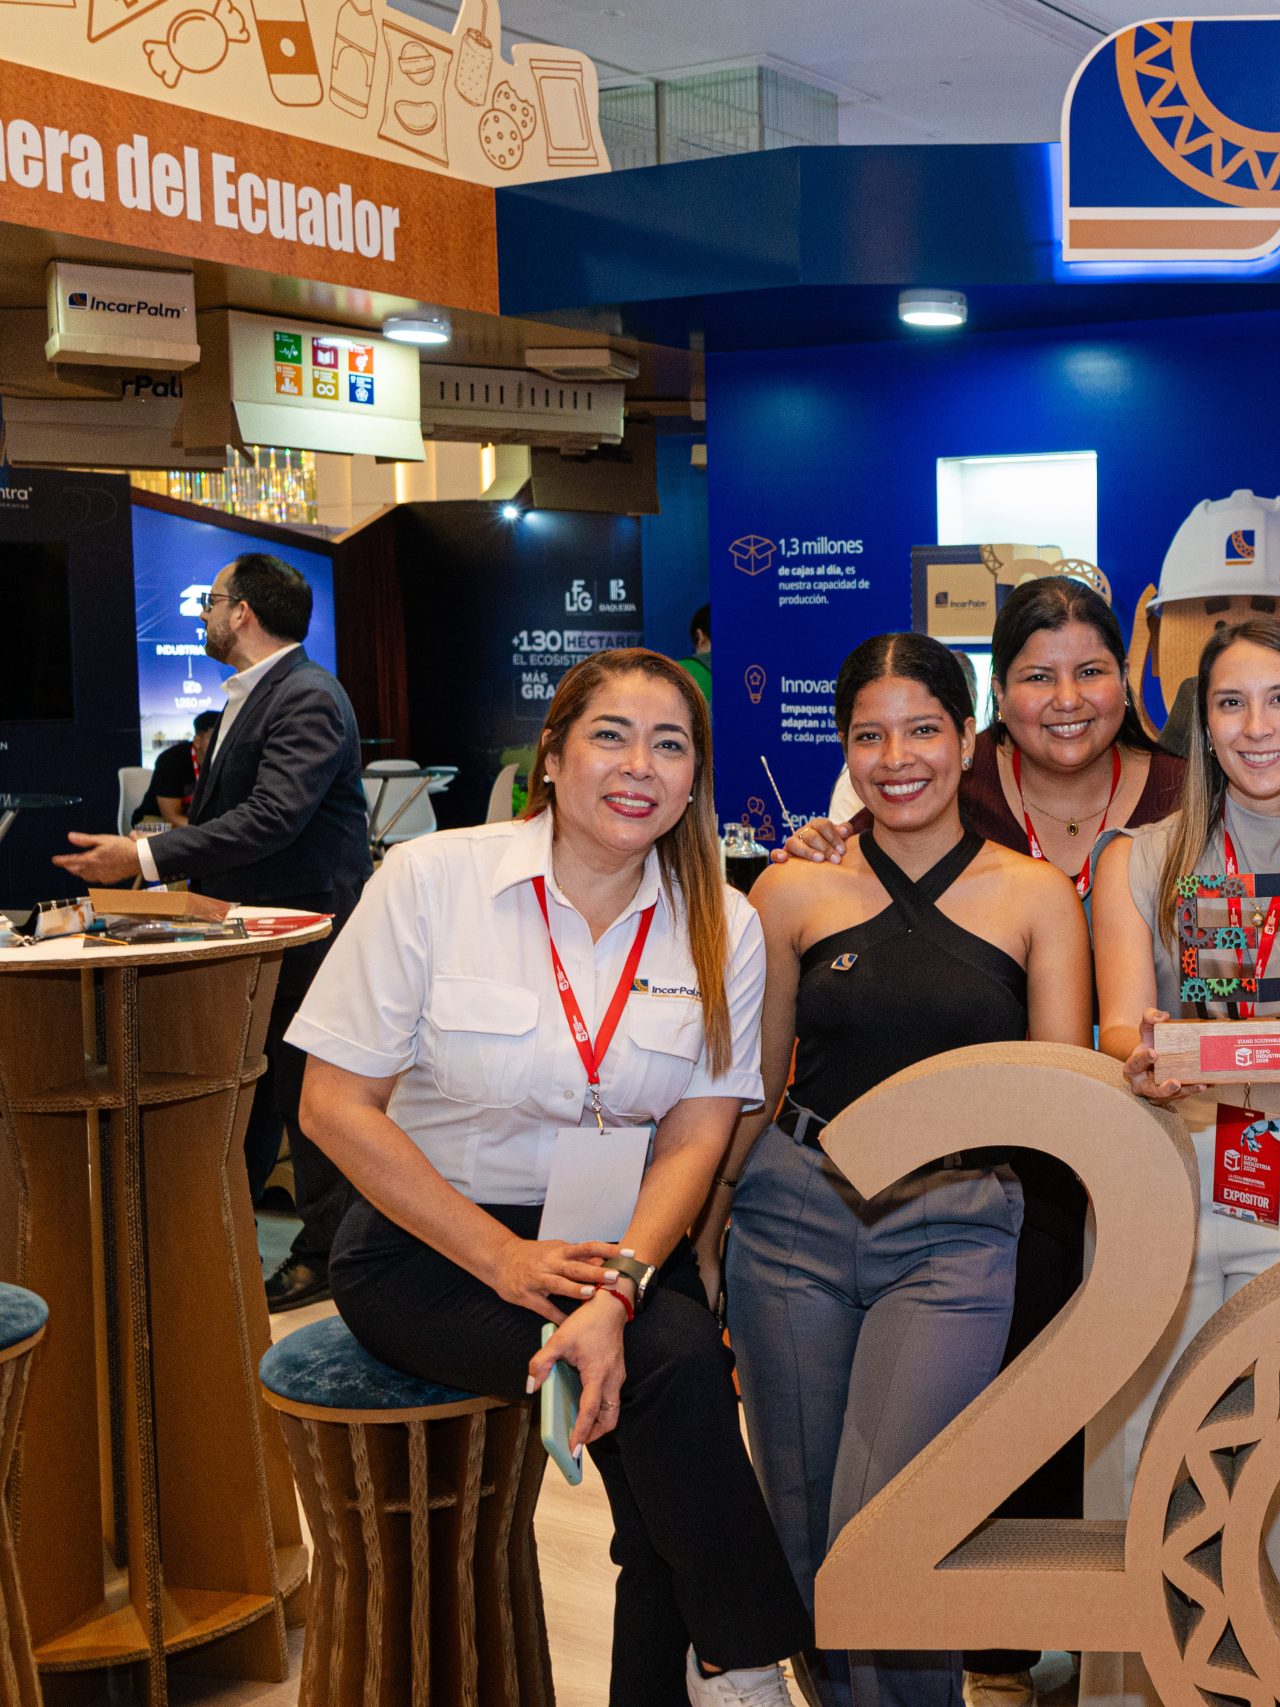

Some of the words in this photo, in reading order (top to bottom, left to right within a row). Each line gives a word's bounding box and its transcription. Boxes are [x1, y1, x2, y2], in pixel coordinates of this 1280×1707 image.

[0, 118, 105, 202] era
[116, 133, 202, 222] del
[211, 151, 400, 262] Ecuador
[90, 296, 181, 319] IncarPalm
[779, 538, 800, 558] 1,3
[802, 536, 864, 555] millones
[778, 566, 790, 576] de
[791, 565, 815, 578] cajas
[816, 565, 825, 575] al
[826, 564, 844, 576] día,
[845, 566, 856, 575] es
[778, 581, 812, 590] nuestra
[813, 579, 857, 592] capacidad
[858, 578, 870, 589] de
[779, 594, 829, 607] producción.
[512, 630, 562, 652] +130
[156, 644, 206, 656] INDUSTRIA
[512, 653, 527, 666] EL
[521, 669, 548, 684] MÁS
[521, 684, 556, 699] GRA
[781, 676, 837, 694] Innovac
[781, 703, 828, 716] Empaques
[781, 717, 819, 730] adaptan
[820, 720, 827, 729] a
[781, 731, 793, 742] de
[794, 731, 815, 742] cada
[1243, 1155, 1258, 1163] EXPO
[1243, 1160, 1271, 1172] INDUSTRIA
[1223, 1187, 1270, 1210] EXPOSITOR
